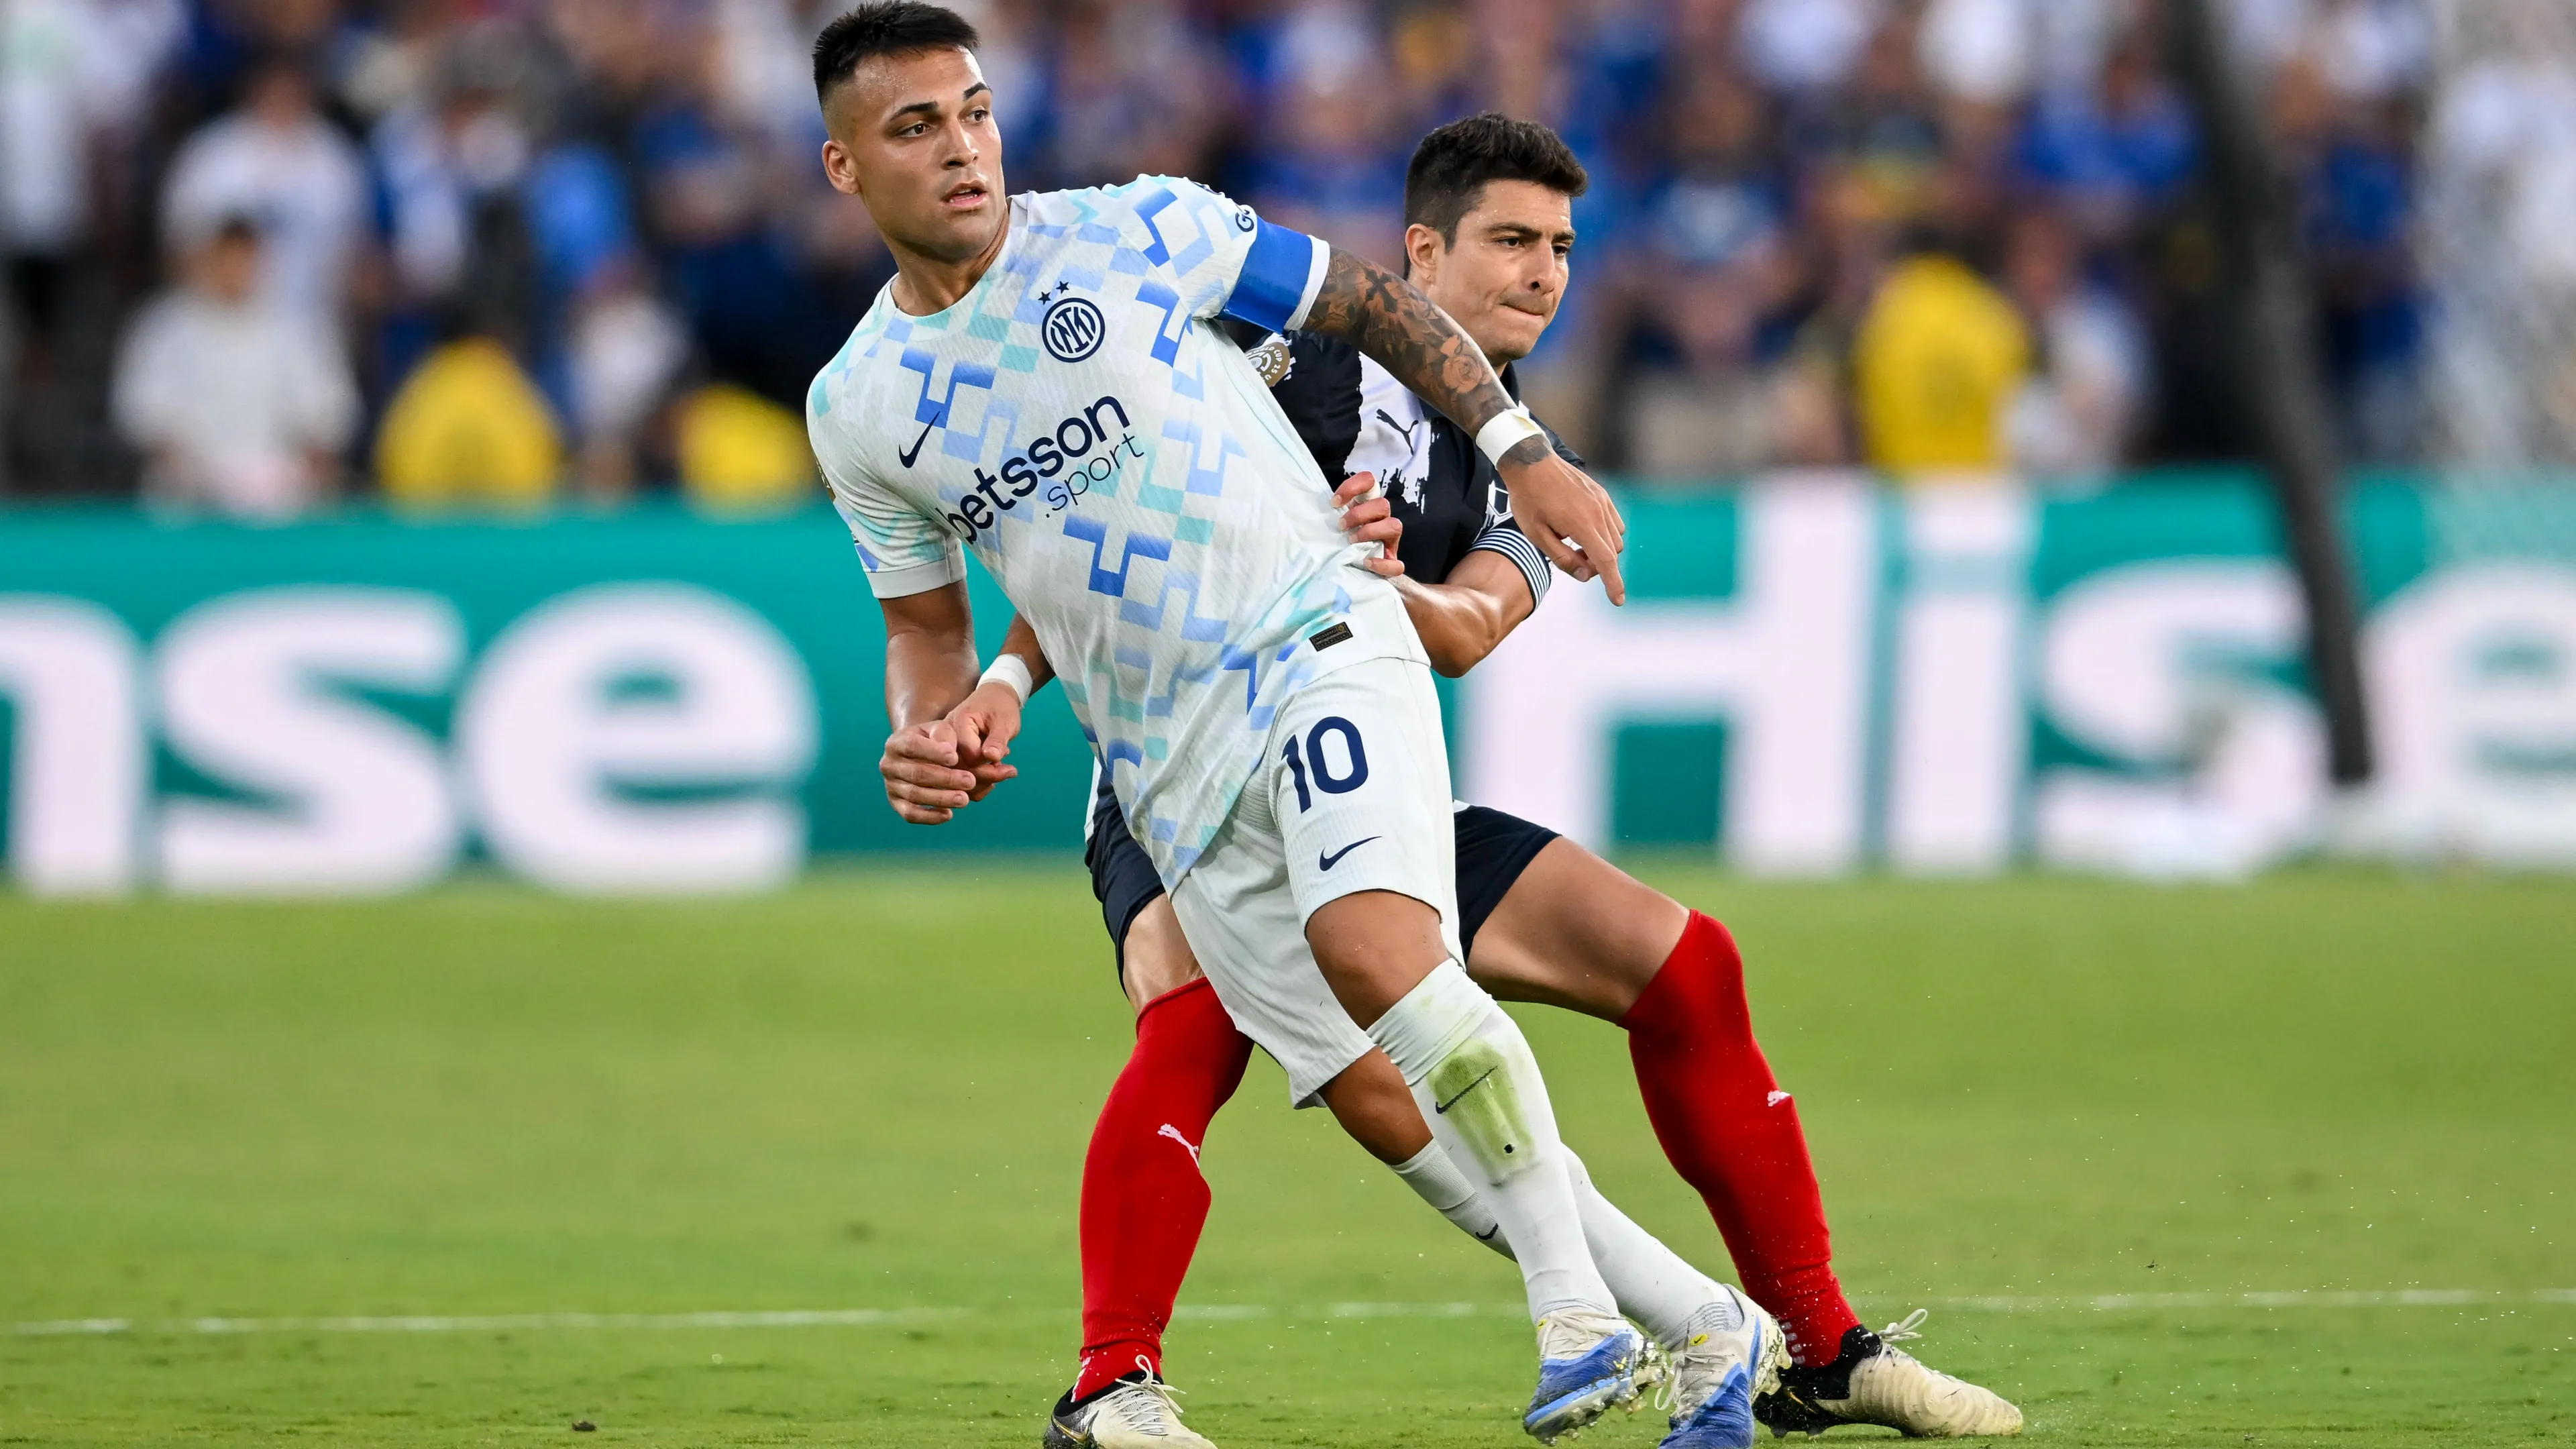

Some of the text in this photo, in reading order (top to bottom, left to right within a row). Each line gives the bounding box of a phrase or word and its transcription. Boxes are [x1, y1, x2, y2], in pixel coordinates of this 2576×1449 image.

[1271, 364, 1281, 374] 25
[1274, 350, 1283, 362] CUP
[934, 396, 1131, 545] betsson
[1281, 716, 1368, 814] 10
